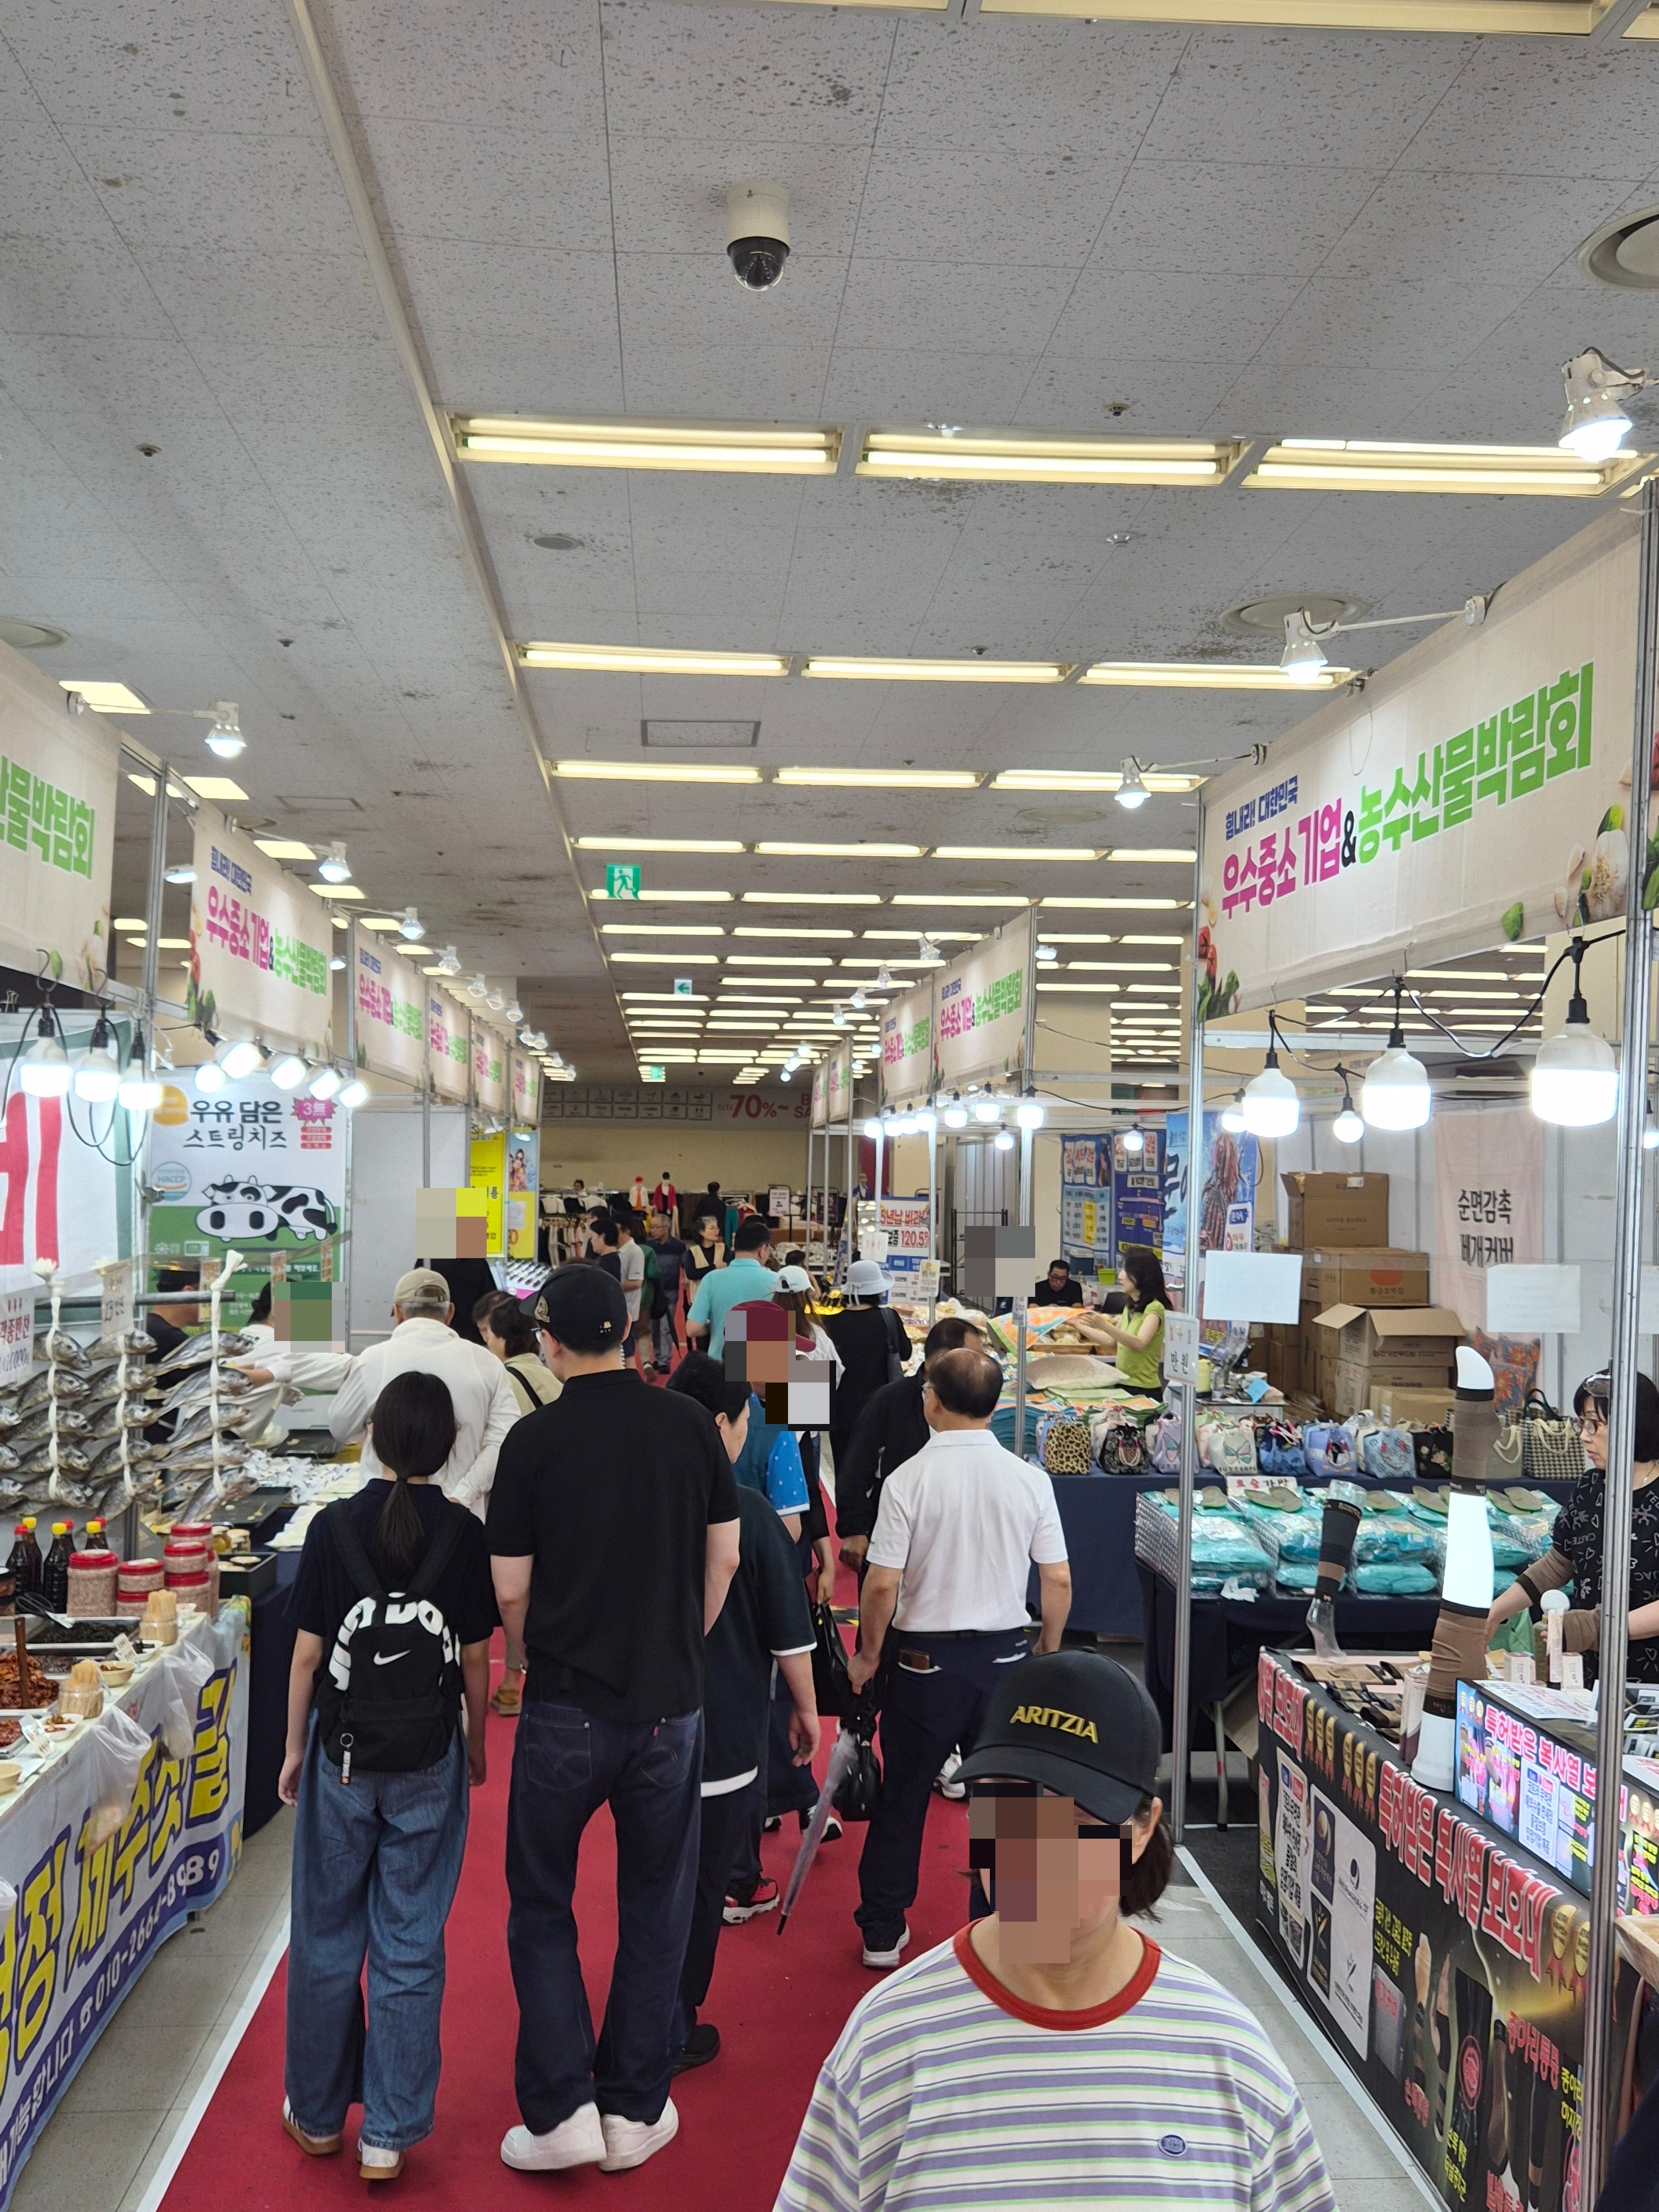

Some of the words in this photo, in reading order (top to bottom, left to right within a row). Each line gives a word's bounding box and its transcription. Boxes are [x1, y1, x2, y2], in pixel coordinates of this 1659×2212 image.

[0, 755, 95, 880] 물박람회
[1225, 811, 1255, 841] 힘내라!
[1258, 775, 1298, 823] 대한민국
[191, 1100, 234, 1123] 우유
[239, 1100, 283, 1123] 담은
[183, 1123, 288, 1151] 스트링치즈
[1458, 1188, 1512, 1224] 순면감촉
[1460, 1233, 1514, 1268] 베개커버
[1169, 1326, 1192, 1345] 1+1
[1010, 1705, 1099, 1744] ARITZIA
[1484, 1704, 1537, 1764] 특허받은
[1538, 1735, 1582, 1792] 복사열
[1379, 1761, 1438, 1888] 특허받은
[1435, 1808, 1496, 1931] 복사열
[1508, 2008, 1560, 2091] 종아리통증
